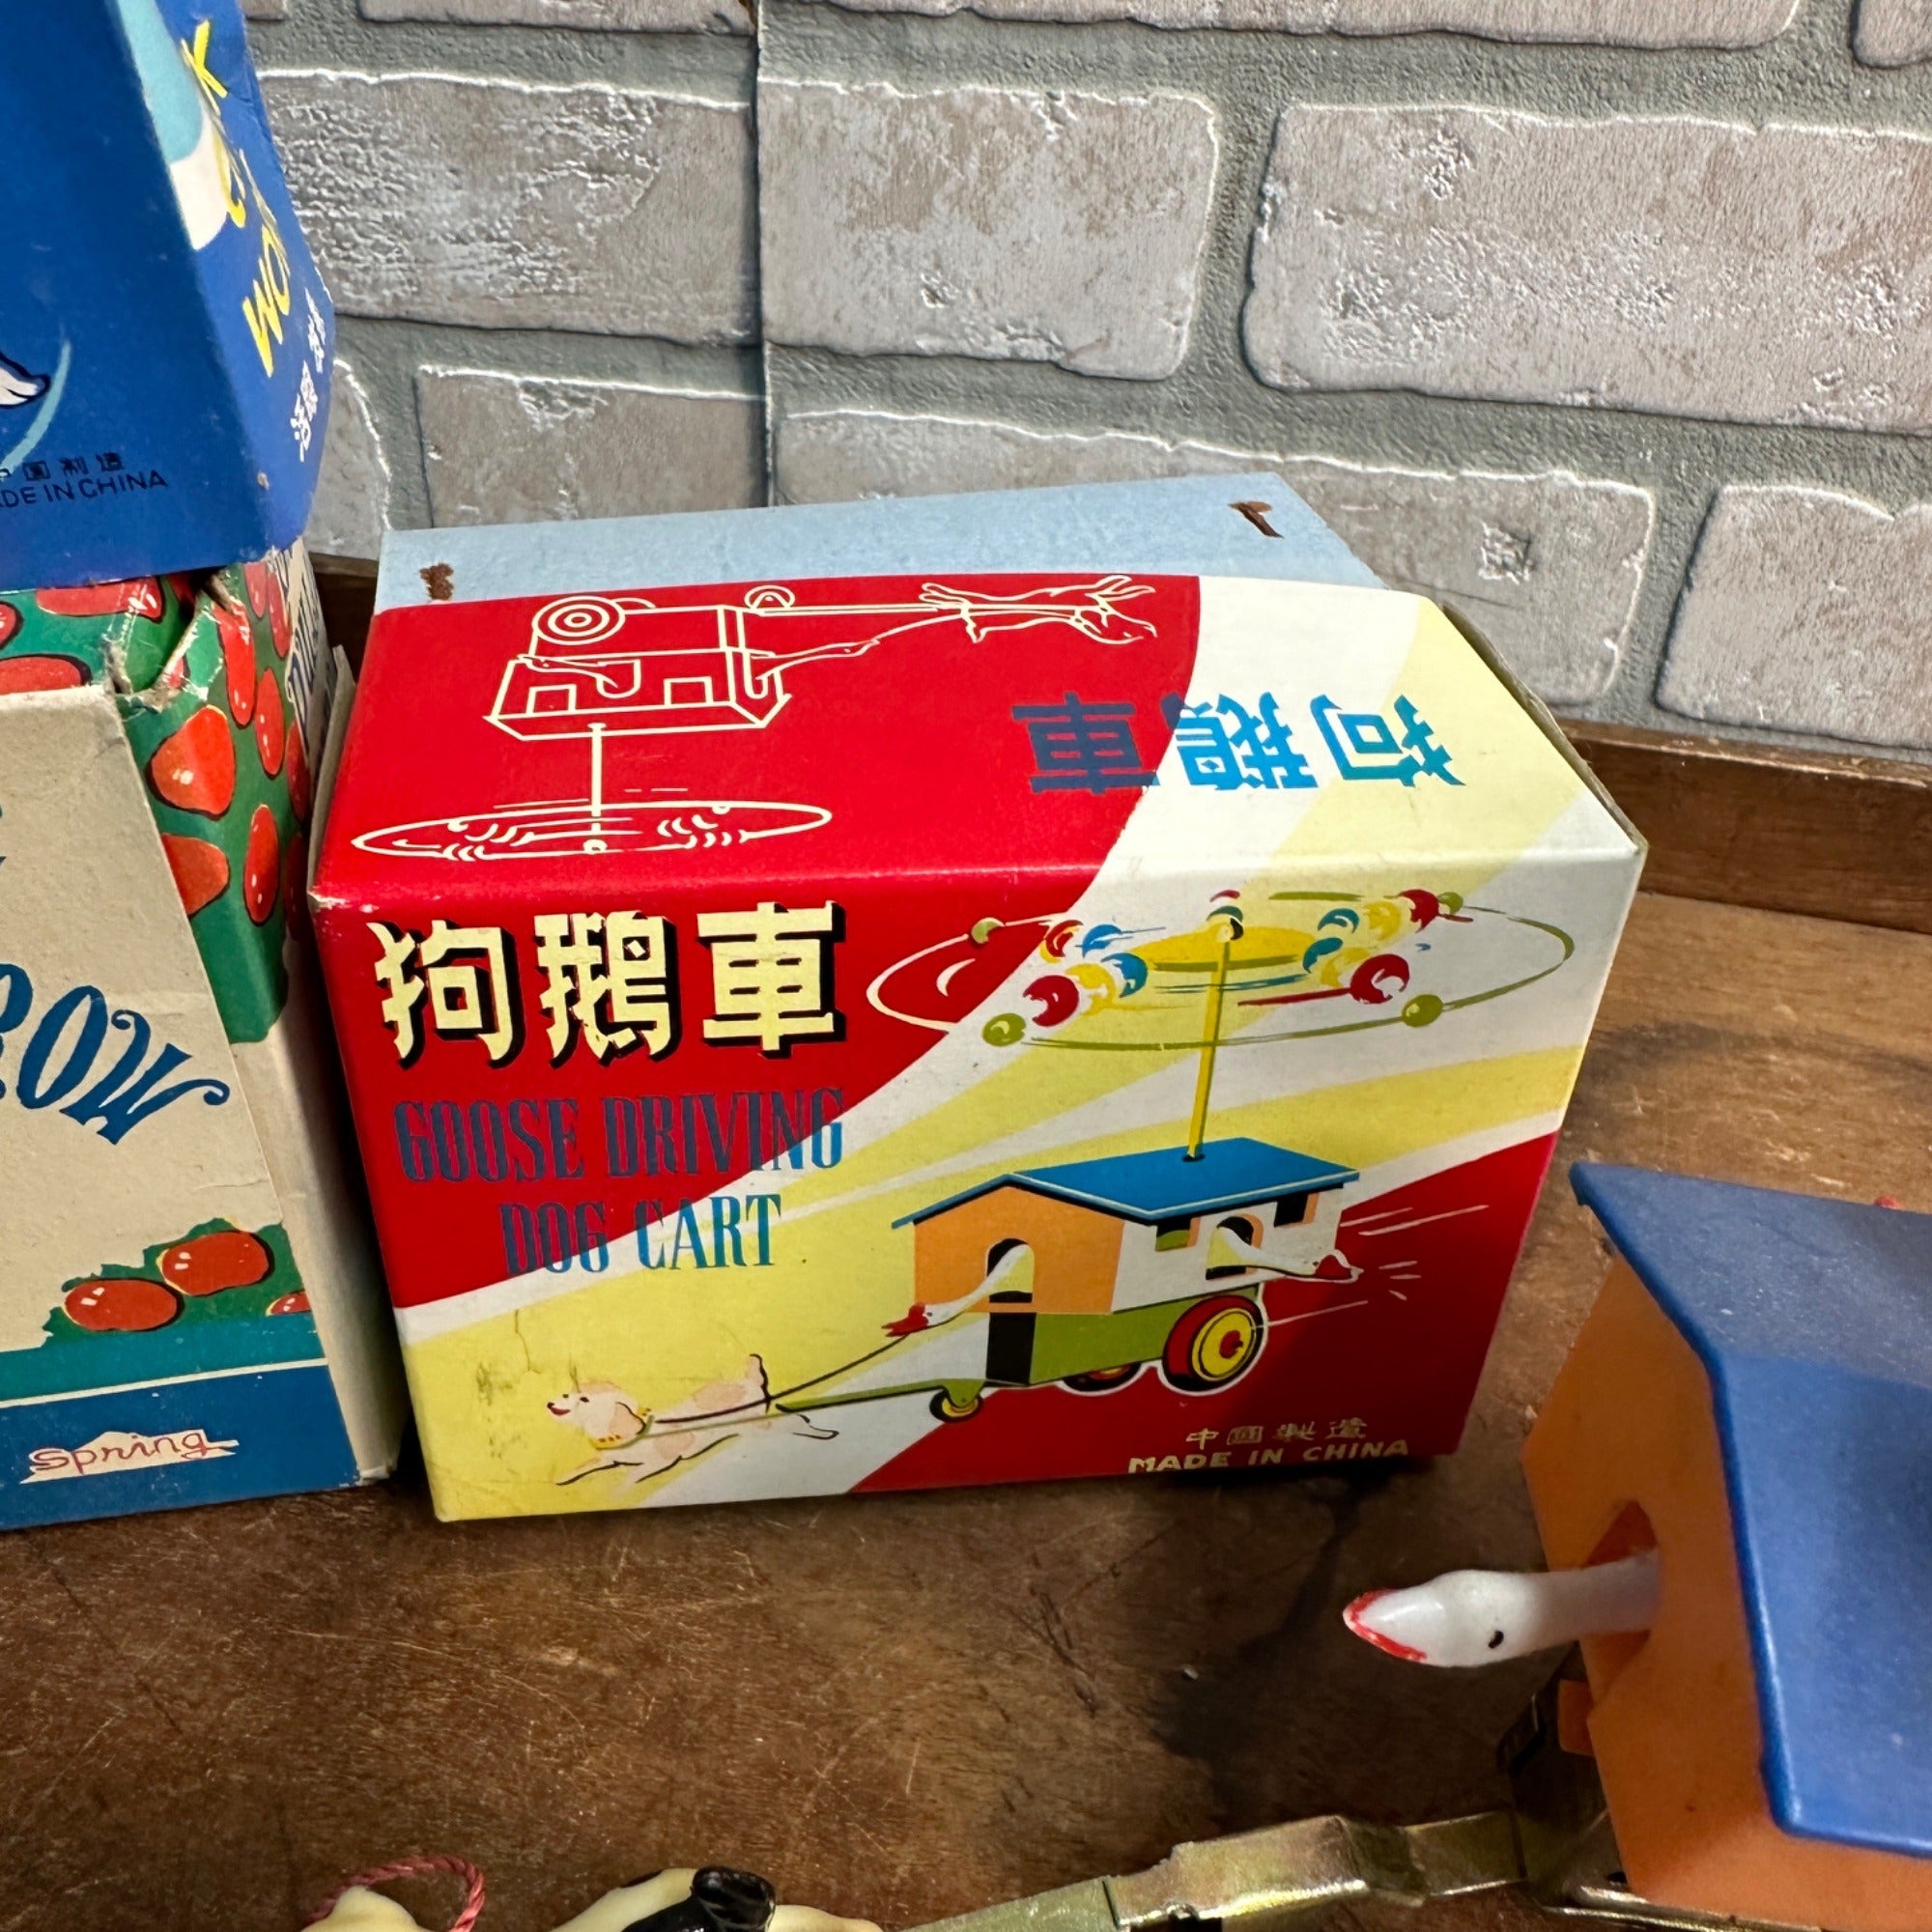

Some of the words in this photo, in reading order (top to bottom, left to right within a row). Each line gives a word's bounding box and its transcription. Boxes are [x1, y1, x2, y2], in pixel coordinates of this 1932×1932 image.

[43, 479, 76, 503] IN
[78, 469, 169, 499] CHINA
[366, 900, 846, 1068] 狗鵝車
[393, 1094, 585, 1183] GOOSE
[601, 1088, 845, 1179] DRIVING
[498, 1200, 611, 1277] DOG
[635, 1193, 782, 1271] CART
[1127, 1451, 1233, 1474] MADE
[1247, 1448, 1285, 1466] IN
[1302, 1439, 1409, 1463] CHINA
